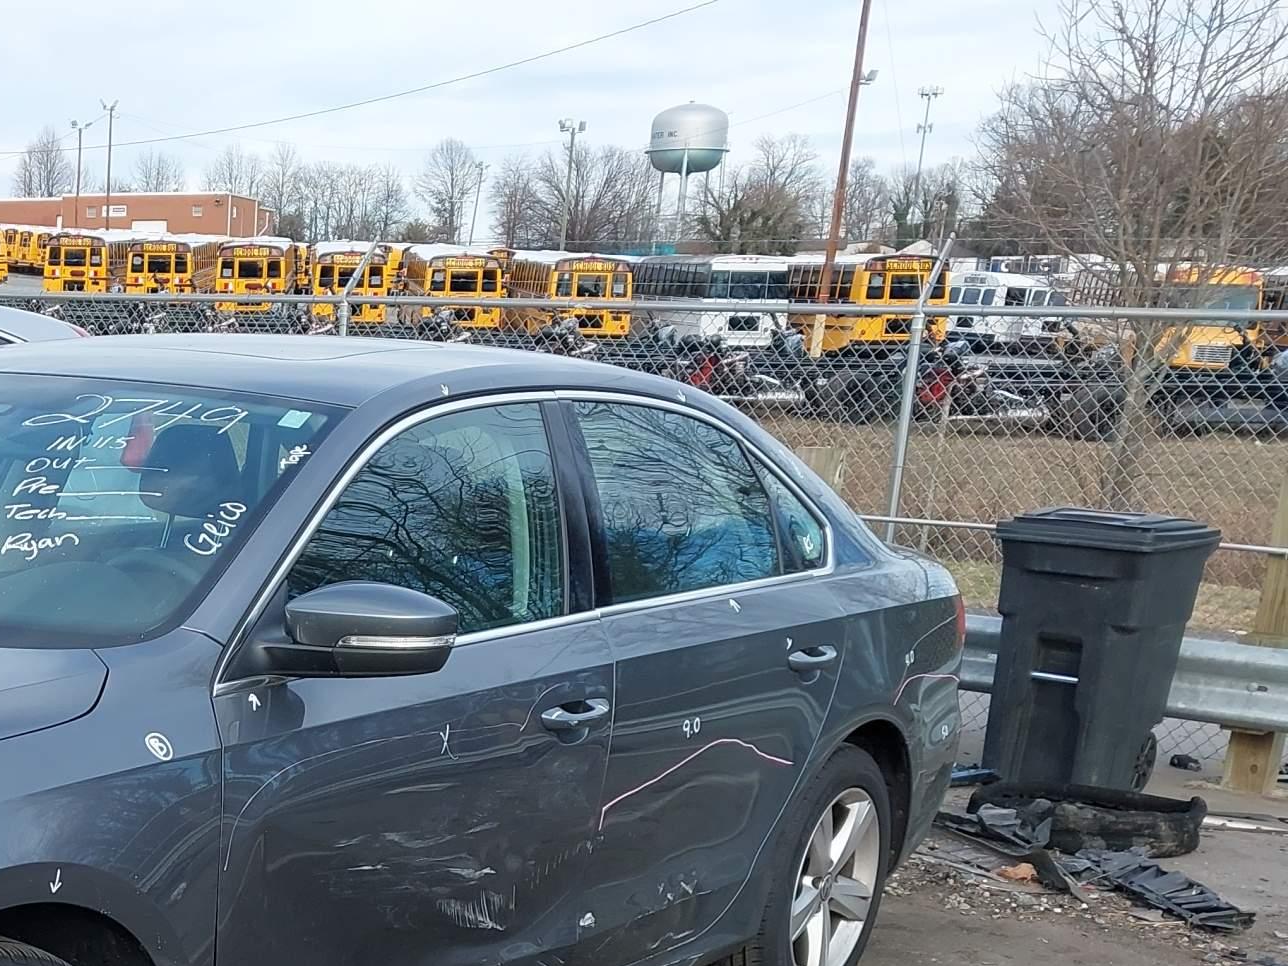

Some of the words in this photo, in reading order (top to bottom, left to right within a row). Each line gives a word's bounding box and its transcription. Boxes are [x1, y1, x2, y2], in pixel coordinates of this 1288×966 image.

[22, 394, 249, 434] 2749
[46, 435, 87, 451] IN
[12, 476, 62, 497] Pre
[1, 533, 80, 560] Ryan
